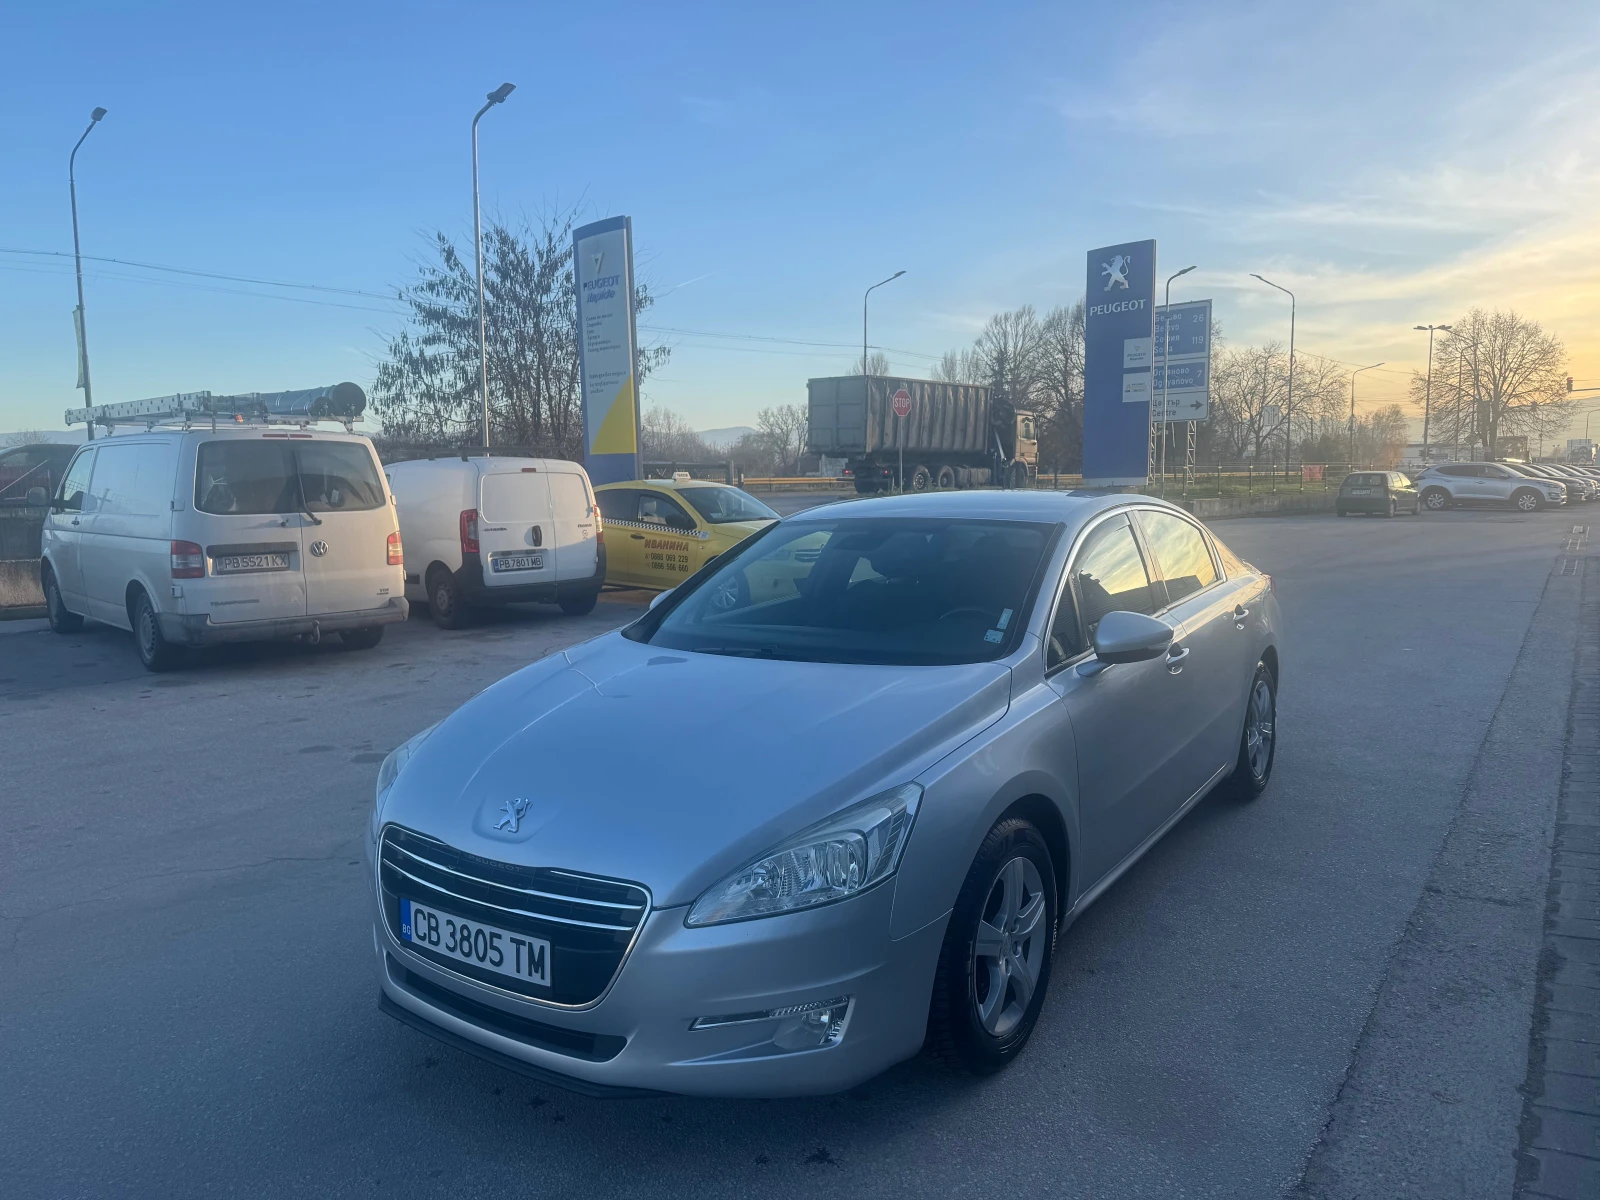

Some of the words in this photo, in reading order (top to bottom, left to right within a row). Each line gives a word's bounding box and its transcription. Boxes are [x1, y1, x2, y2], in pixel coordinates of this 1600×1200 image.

[583, 274, 620, 291] PEUGEOT
[1090, 299, 1146, 316] PEUGEOT
[1192, 313, 1204, 323] 26
[1155, 324, 1180, 333] Beovo
[1192, 335, 1204, 345] 119
[1197, 369, 1203, 378] 7
[1153, 378, 1194, 388] Ogyanovo
[895, 398, 909, 408] STOP
[1152, 399, 1180, 408] Цетър
[402, 923, 411, 935] BG
[414, 908, 441, 947] CB
[445, 919, 504, 968] 3805
[509, 936, 546, 981] TM
